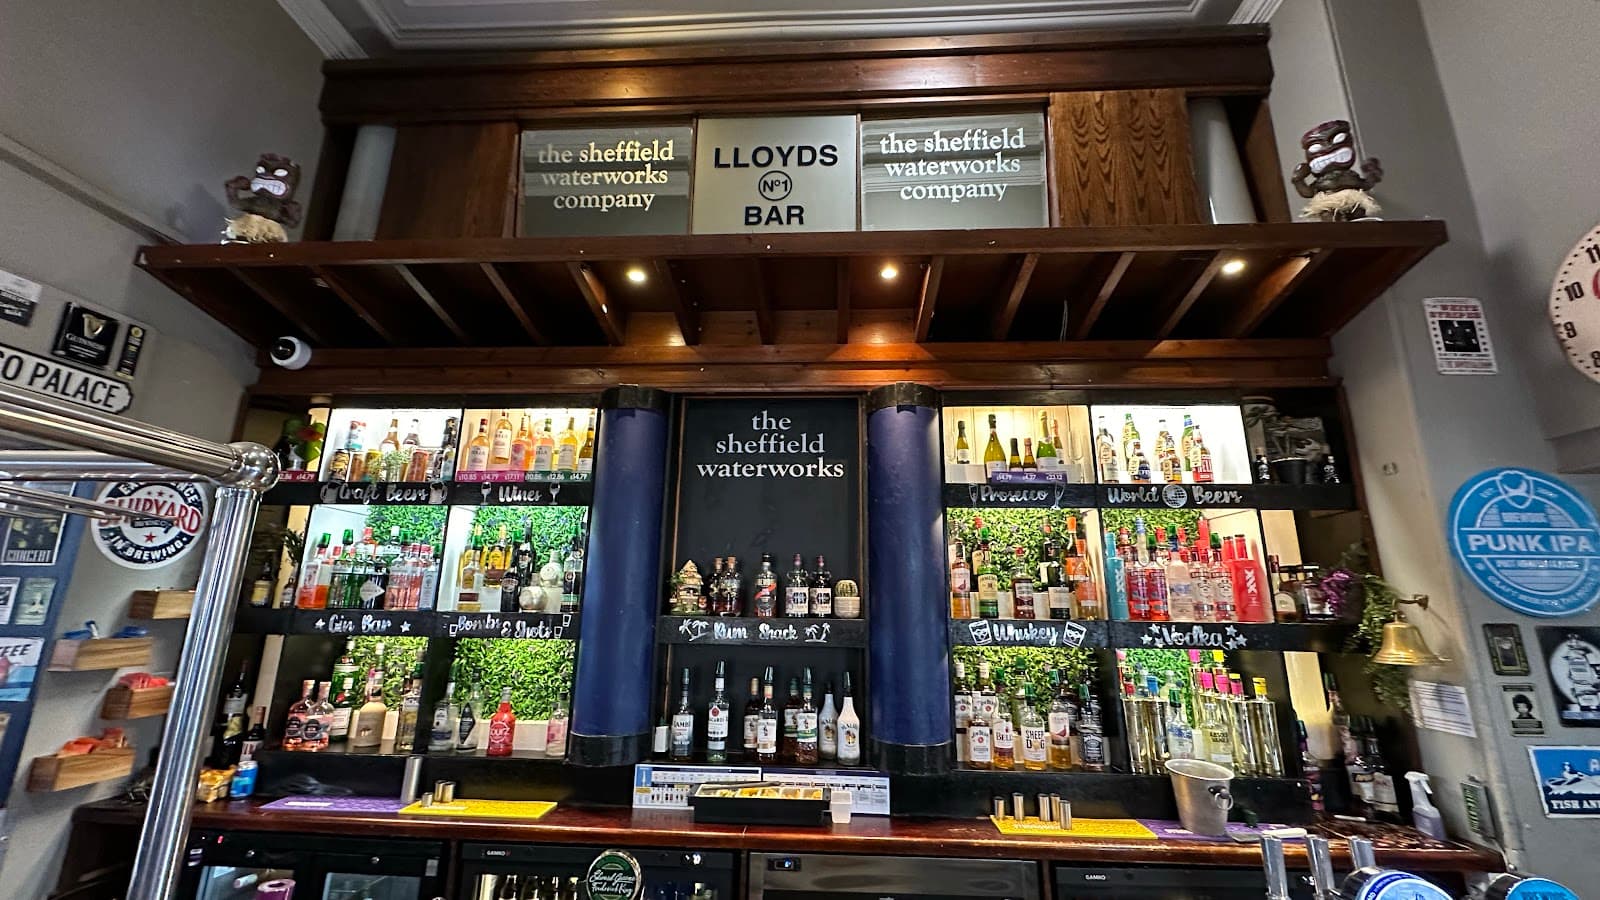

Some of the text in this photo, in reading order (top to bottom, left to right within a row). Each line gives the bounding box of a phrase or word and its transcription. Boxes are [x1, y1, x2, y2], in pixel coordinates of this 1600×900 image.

[880, 127, 1026, 154] the sheffield
[538, 139, 675, 164] the sheffield
[714, 144, 839, 168] LLOYDS
[884, 151, 1021, 177] waterworks
[541, 163, 668, 186] waterworks
[553, 193, 656, 212] company
[900, 183, 1008, 202] company
[744, 205, 805, 226] BAR
[1564, 282, 1584, 301] 10
[1563, 321, 1577, 338] 9
[28, 362, 120, 408] PALACE
[751, 410, 792, 430] the
[716, 433, 825, 454] sheffield
[697, 457, 845, 478] waterworks
[339, 482, 428, 505] Craft Beers
[498, 484, 542, 502] Wines
[981, 485, 1049, 502] Prosecco
[1107, 485, 1243, 504] World Beers
[123, 539, 184, 561] BREWING
[1467, 534, 1596, 553] PUNK IPA
[328, 613, 392, 633] Gin Bar
[500, 620, 512, 637] &
[514, 619, 553, 639] Shots
[713, 621, 798, 640] Rum Shack
[992, 622, 1058, 646] Whiskey
[1161, 624, 1226, 650] Vodka
[1551, 800, 1600, 809] FISH AN
